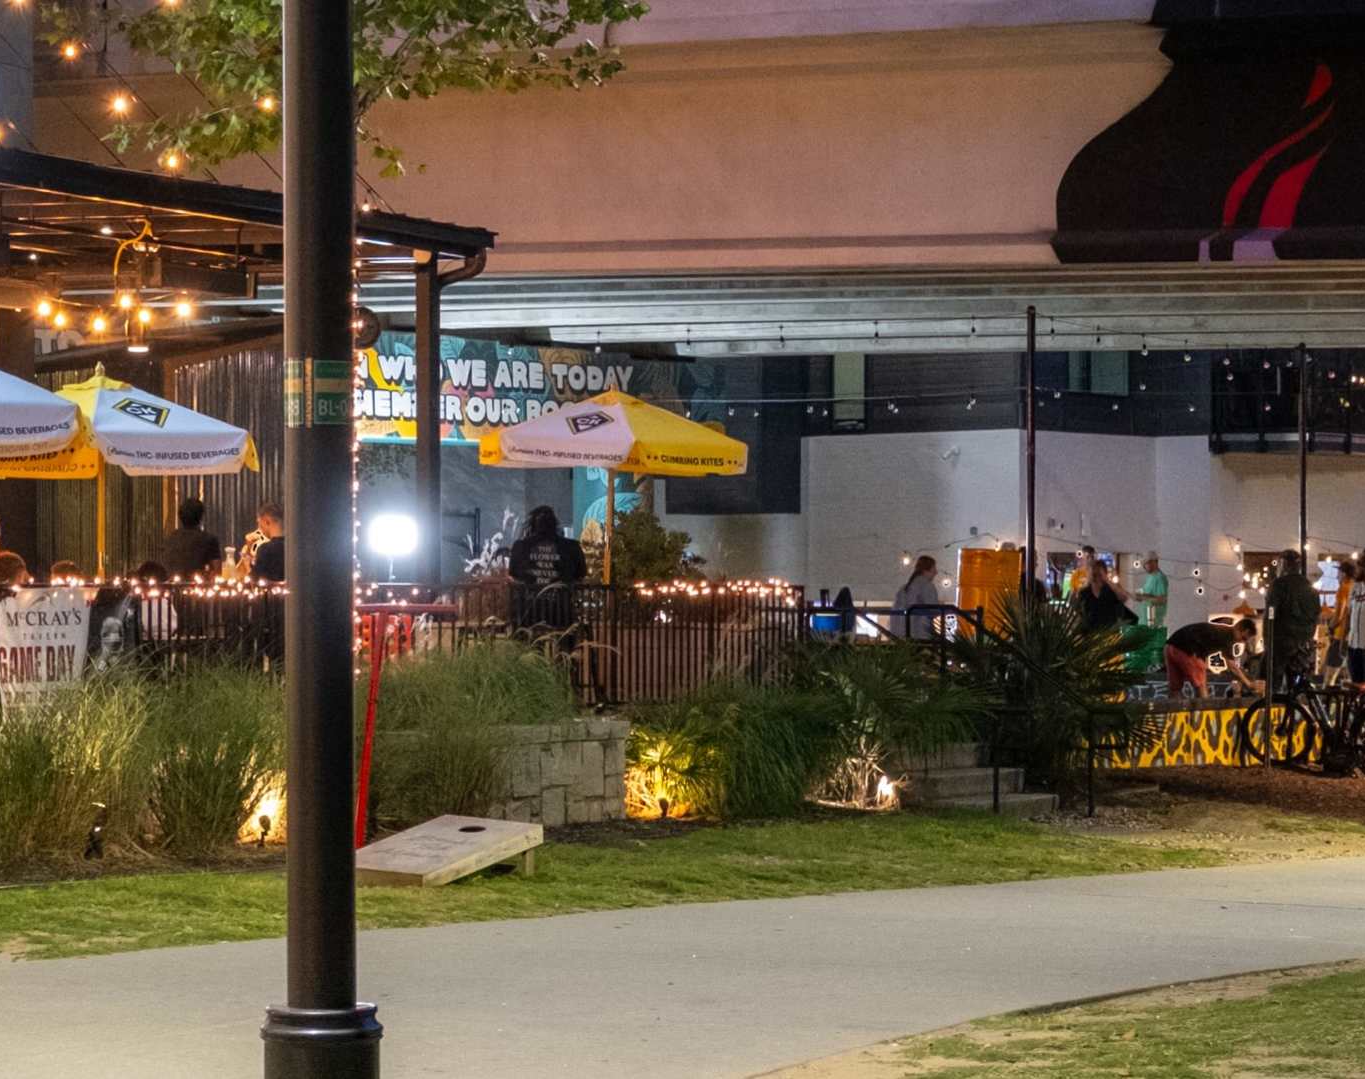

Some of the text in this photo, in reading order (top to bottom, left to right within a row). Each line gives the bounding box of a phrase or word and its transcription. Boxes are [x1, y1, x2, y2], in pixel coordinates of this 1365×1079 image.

[446, 358, 487, 387] WE
[495, 360, 545, 390] ARE
[551, 364, 634, 393] TODAY
[465, 396, 520, 424] OUR
[700, 456, 725, 467] KITES
[46, 644, 76, 682] DAY
